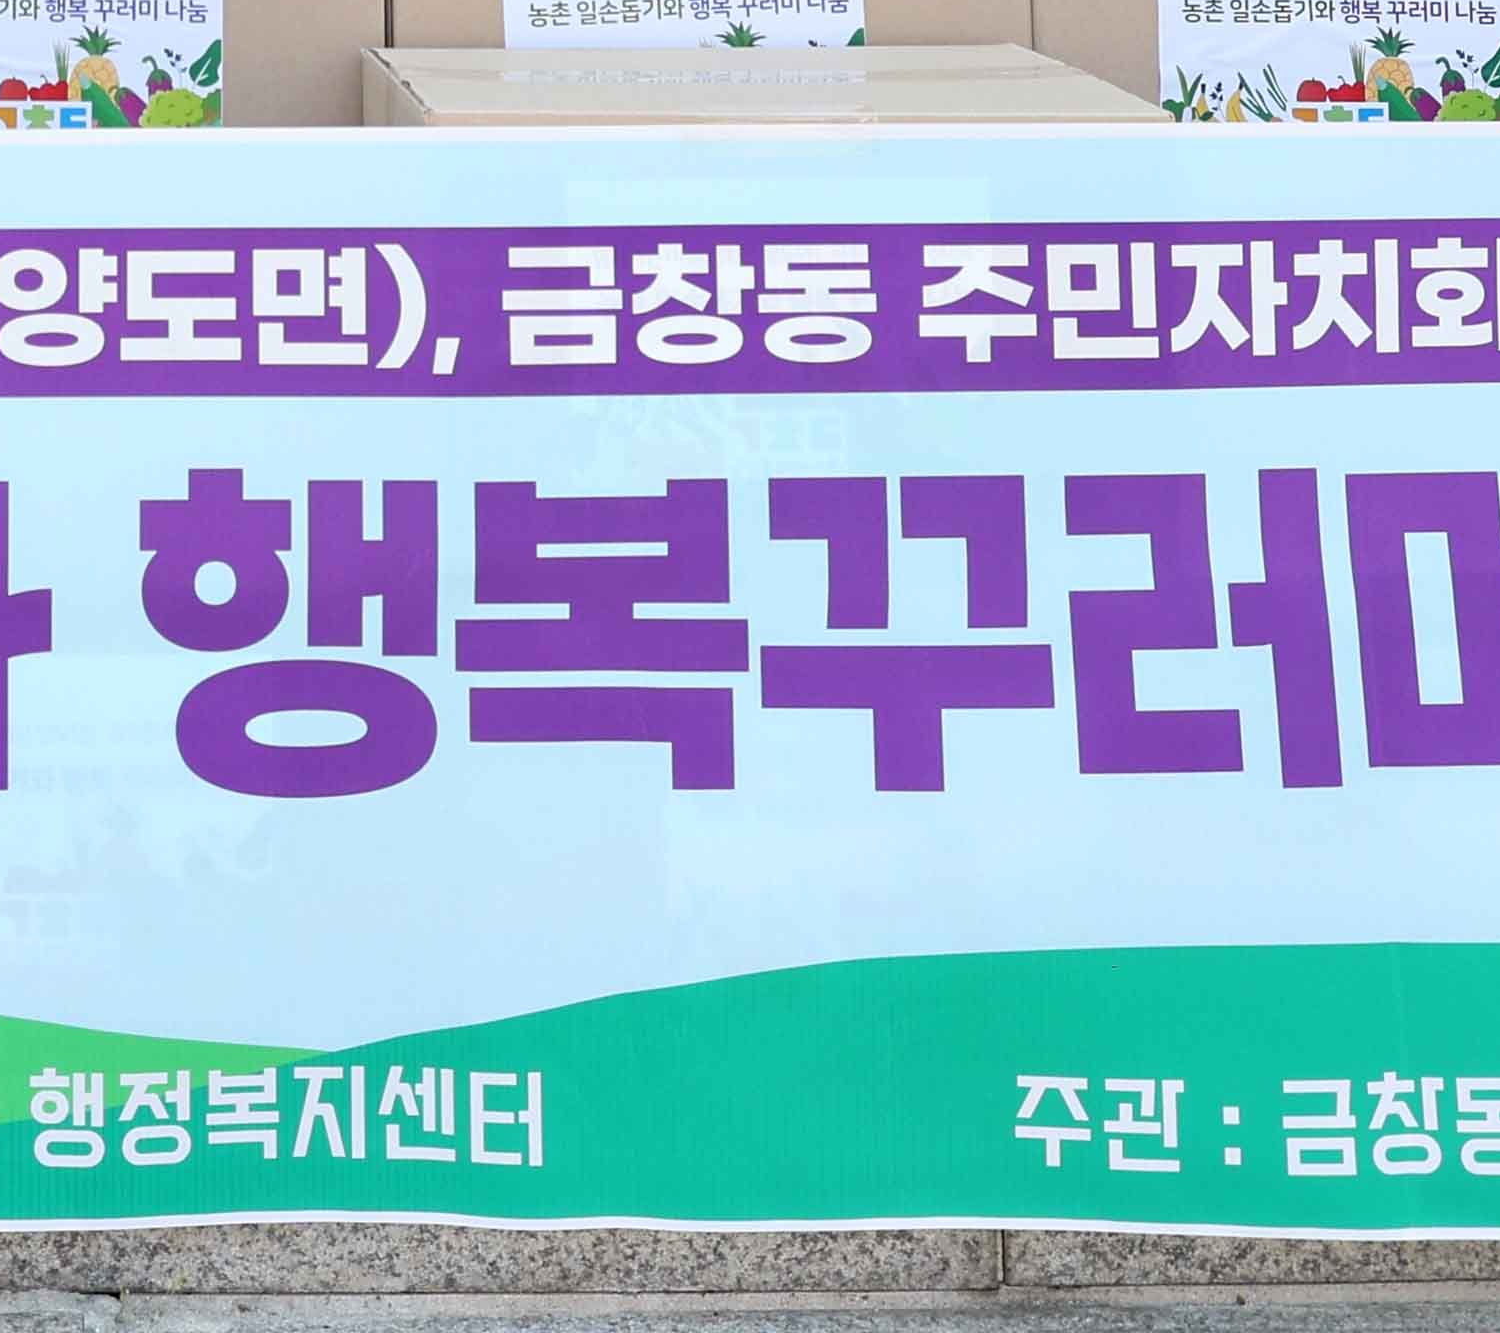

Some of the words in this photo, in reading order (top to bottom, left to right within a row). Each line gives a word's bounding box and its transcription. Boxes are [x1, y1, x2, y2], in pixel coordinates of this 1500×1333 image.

[164, 0, 208, 23] 나눔
[526, 2, 572, 29] 농촌
[1181, 0, 1225, 23] 농촌
[1340, 0, 1383, 25] 행복
[1386, 0, 1451, 24] 꾸러미
[1454, 1, 1497, 25] 나눔
[503, 244, 876, 364] 금창동
[31, 1067, 542, 1166] 행정복지센터
[1016, 1077, 1183, 1171] 주관
